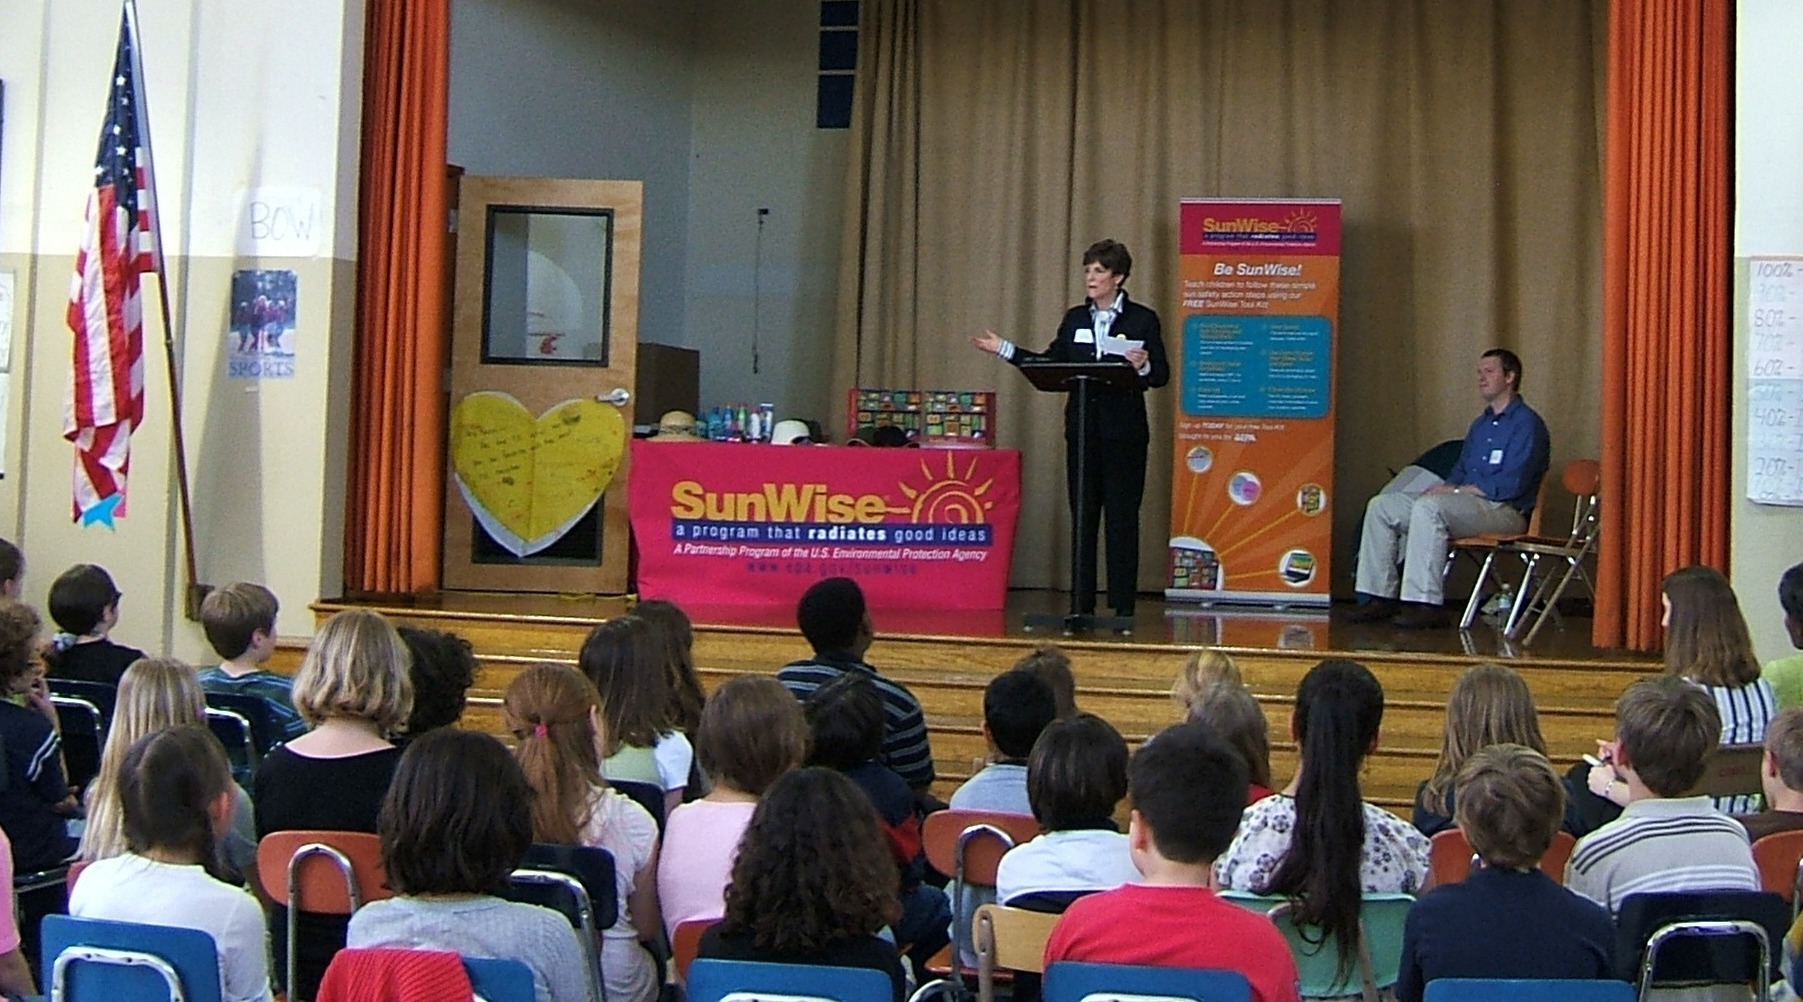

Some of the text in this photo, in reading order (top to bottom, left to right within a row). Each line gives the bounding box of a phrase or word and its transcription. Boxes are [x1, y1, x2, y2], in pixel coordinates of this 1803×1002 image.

[251, 201, 315, 241] BOW
[1203, 218, 1280, 233] SunWise
[1213, 263, 1303, 276] Be SunWise!
[1757, 262, 1793, 278] 100%
[1236, 281, 1245, 289] to
[1182, 299, 1204, 308] FREE
[1205, 300, 1239, 308] SunWise
[1754, 308, 1785, 328] 80%
[228, 361, 294, 378] SPORTS
[1753, 358, 1784, 377] 60%
[1755, 407, 1787, 427] 40%
[1755, 457, 1787, 477] 20%
[670, 480, 888, 525] SunWise
[675, 525, 987, 544] a program that radiates good ideas
[673, 543, 988, 561] A Partnership Program of the U.S. Environmental Protection Agency
